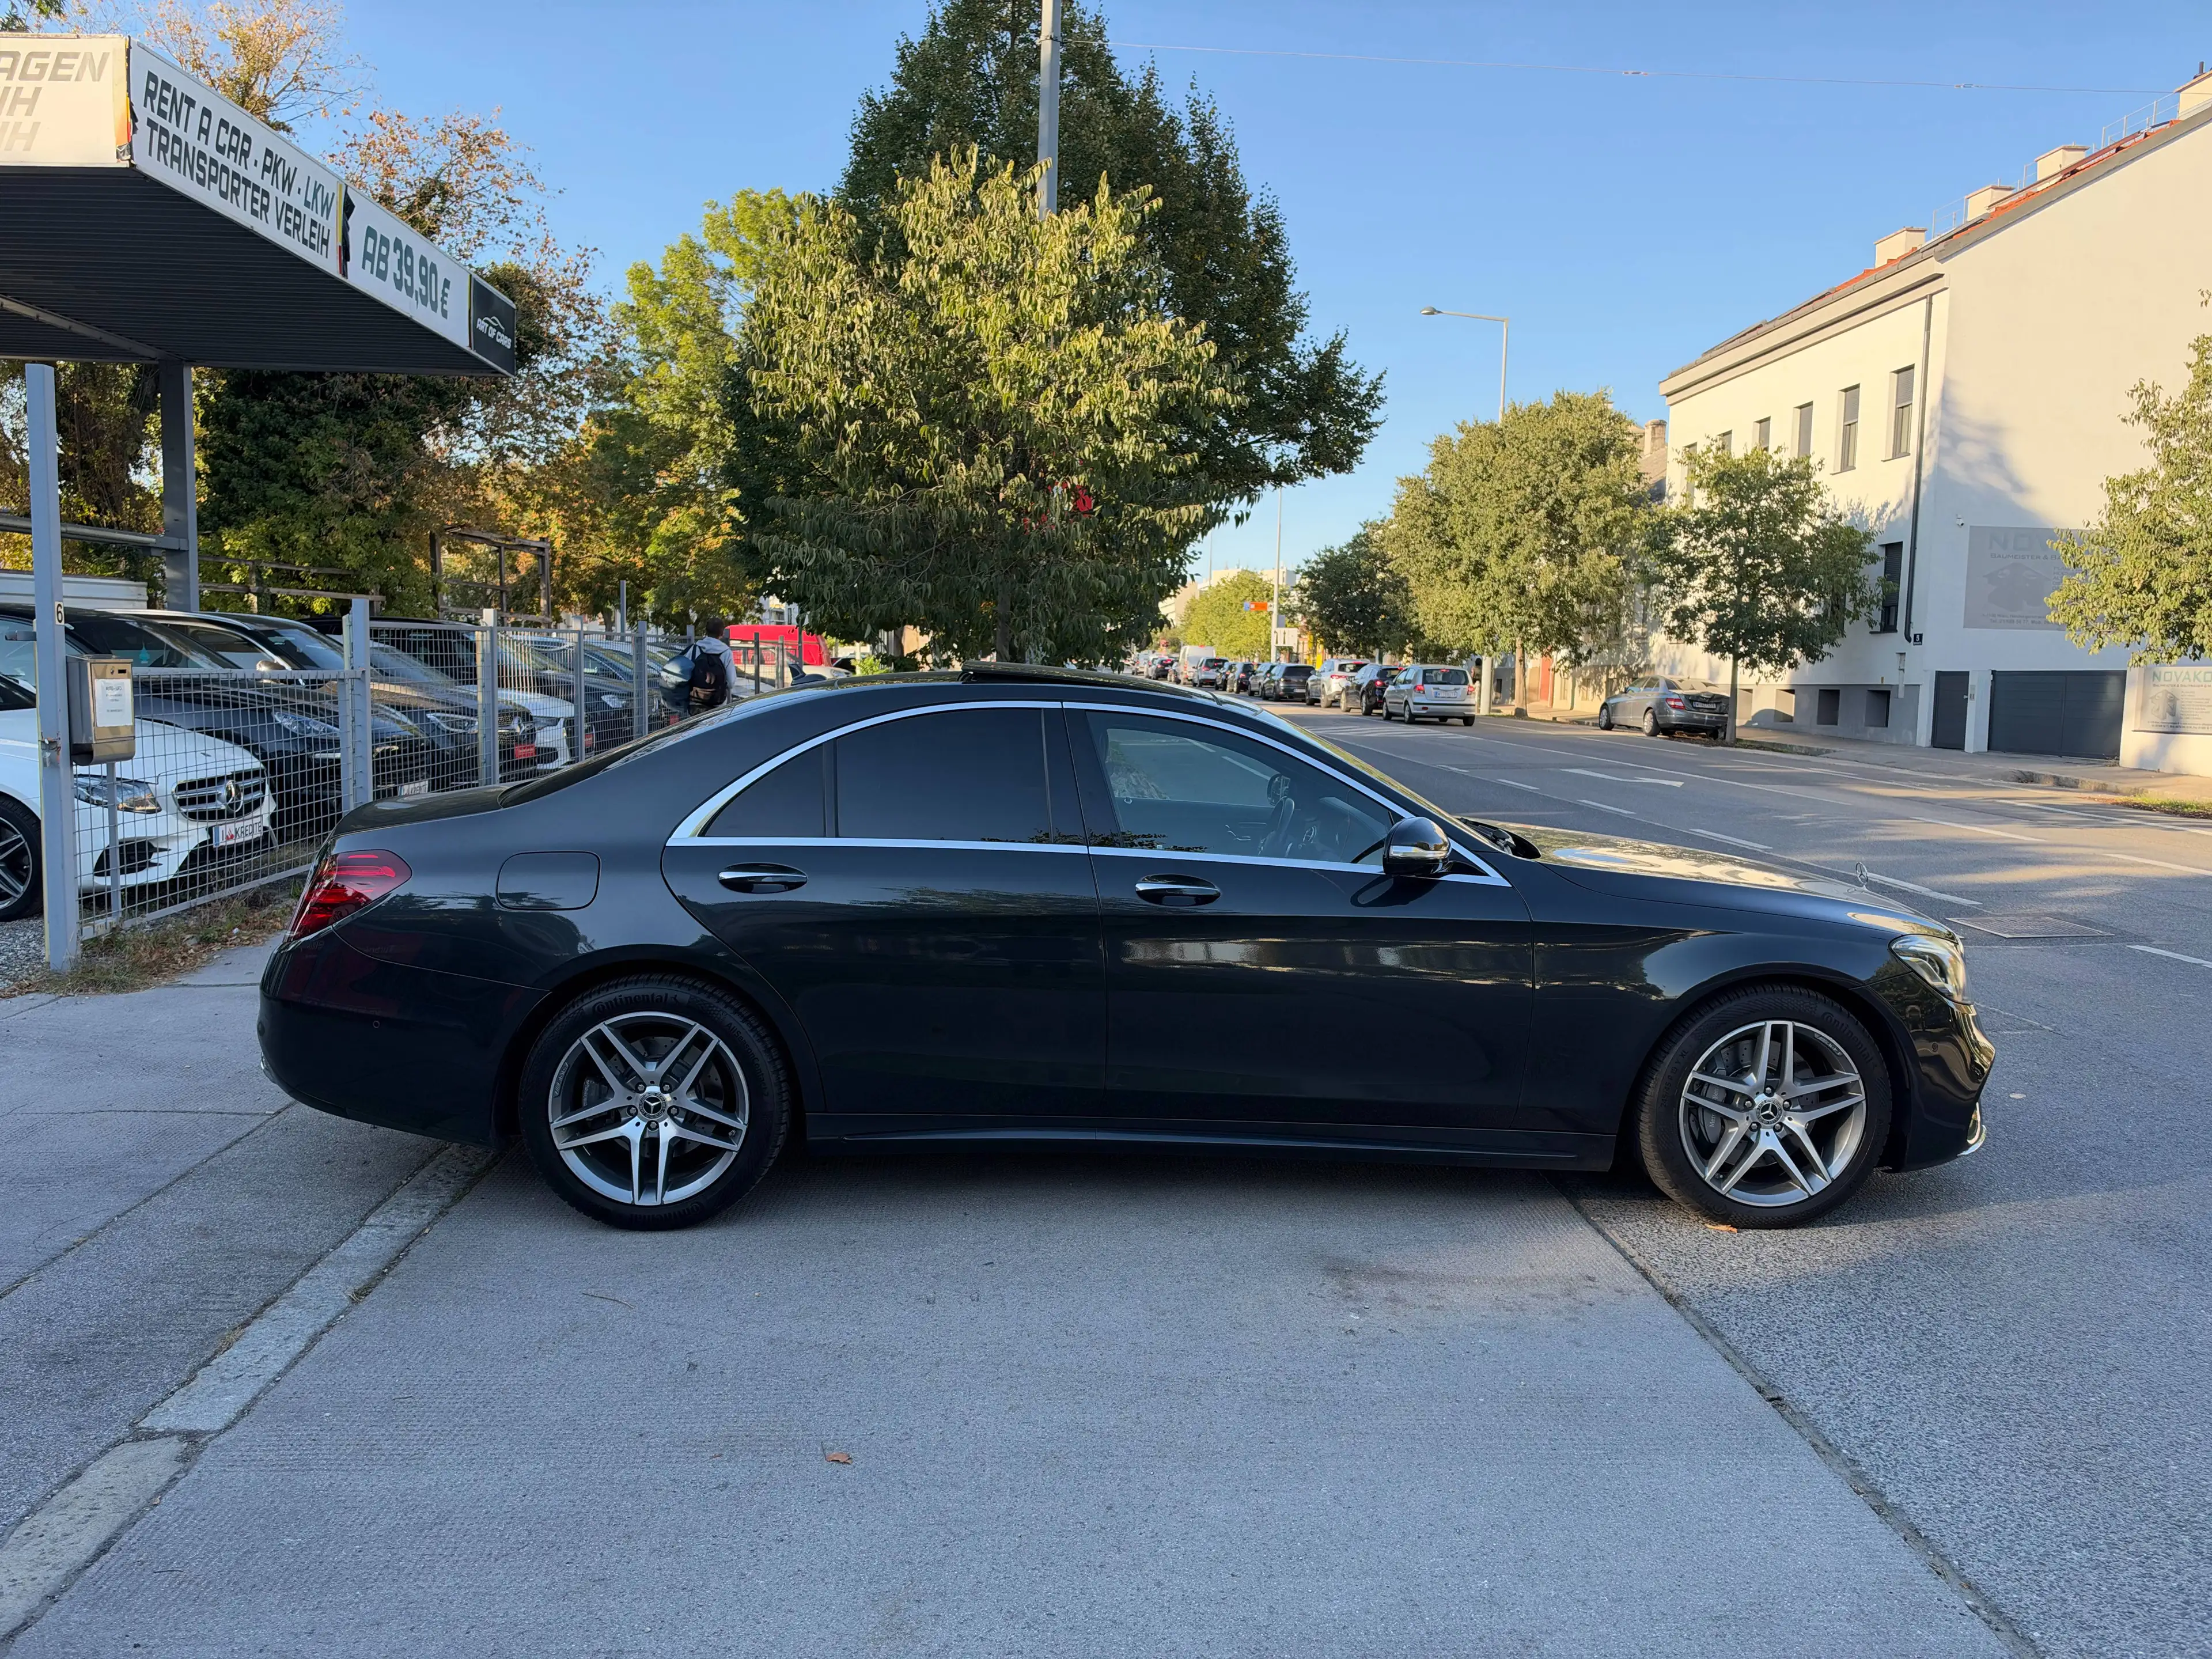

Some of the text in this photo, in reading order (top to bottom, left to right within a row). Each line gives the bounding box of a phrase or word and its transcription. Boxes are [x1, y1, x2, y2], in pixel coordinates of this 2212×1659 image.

[143, 70, 335, 221] RENT A CAR PKW LKW
[146, 117, 331, 259] TRANSPORTER VERLEIH
[361, 225, 451, 320] AB 39,90 €
[476, 318, 512, 349] ART OF CARS
[56, 604, 63, 623] 6
[235, 821, 262, 839] KREDITE
[592, 993, 668, 1014] Continental
[1821, 1012, 1873, 1064] Continental
